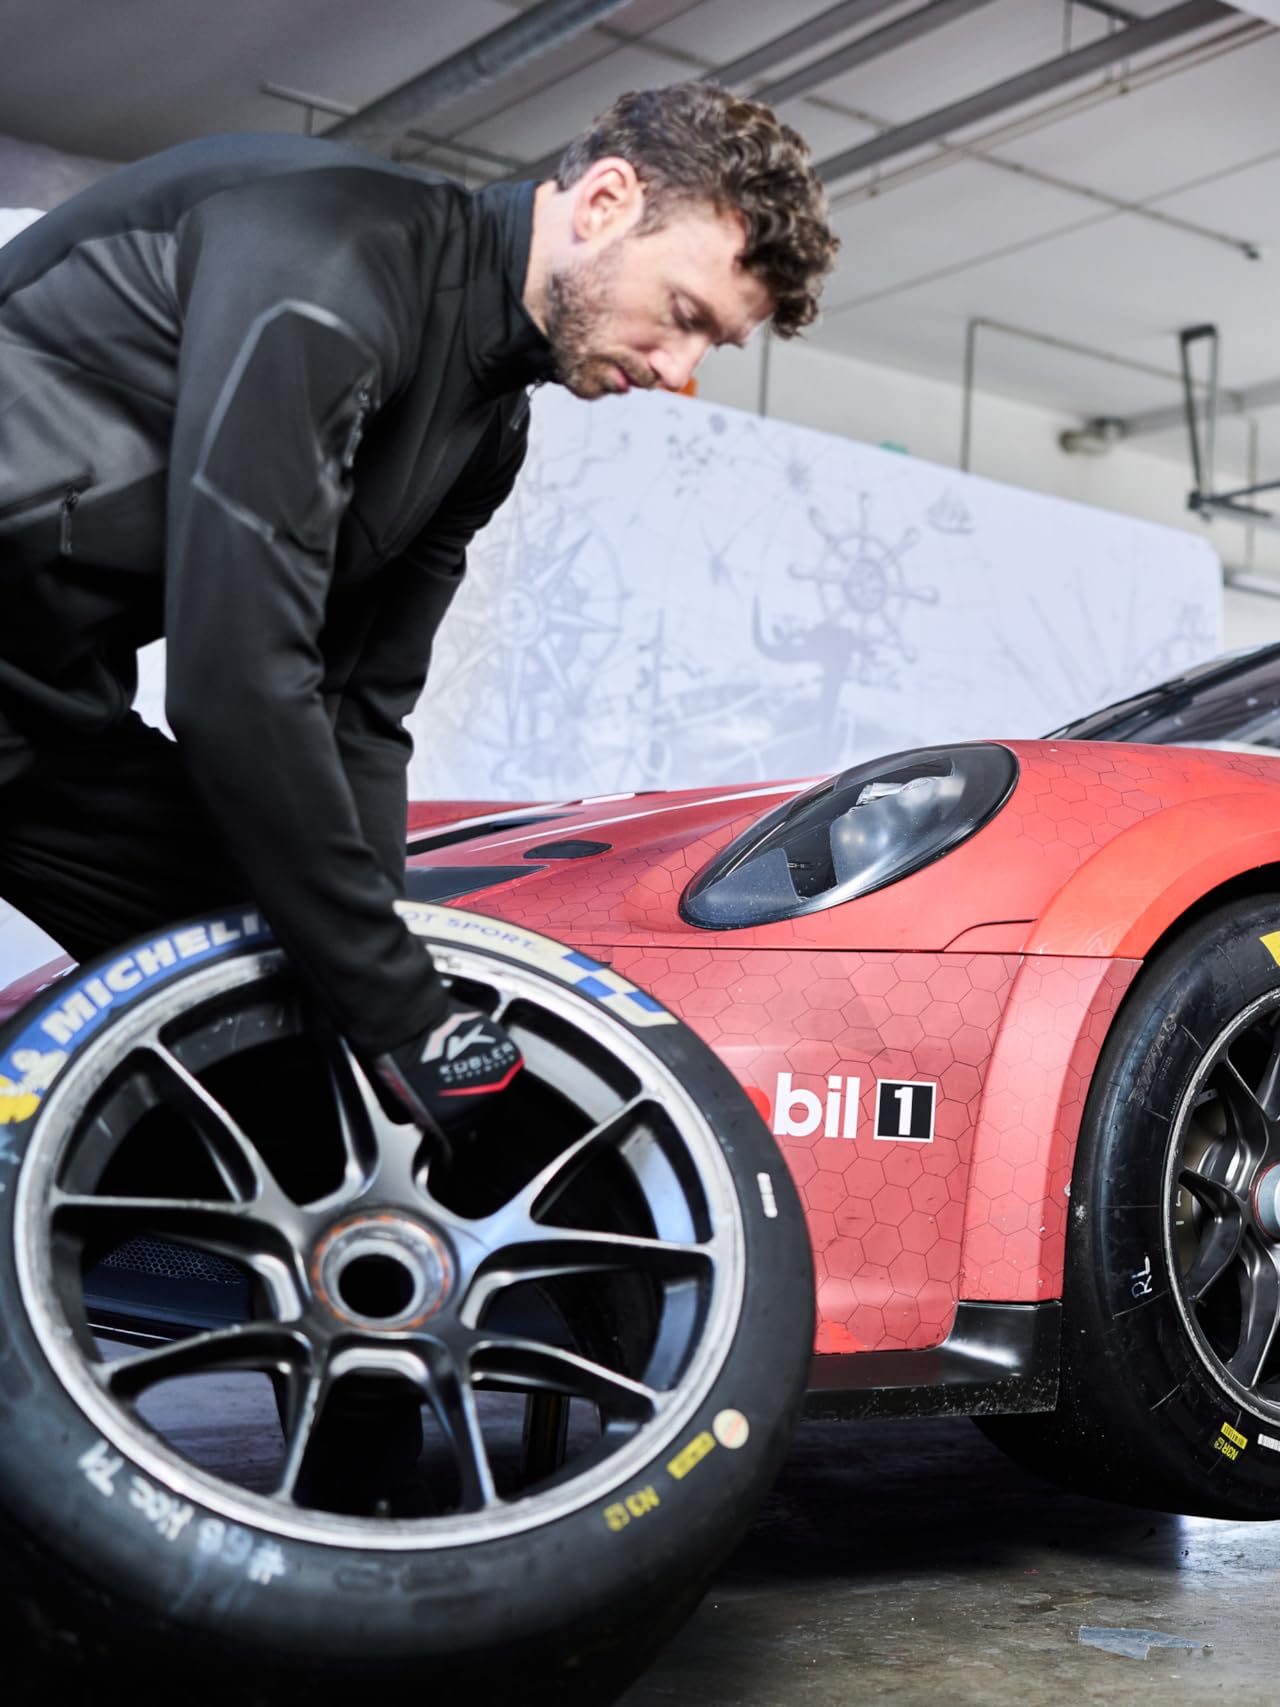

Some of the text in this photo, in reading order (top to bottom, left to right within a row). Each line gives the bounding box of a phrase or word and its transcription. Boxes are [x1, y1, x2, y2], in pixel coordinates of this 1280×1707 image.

[447, 917, 534, 948] SPORT
[40, 912, 270, 1045] MICHELI
[894, 1086, 914, 1136] 1
